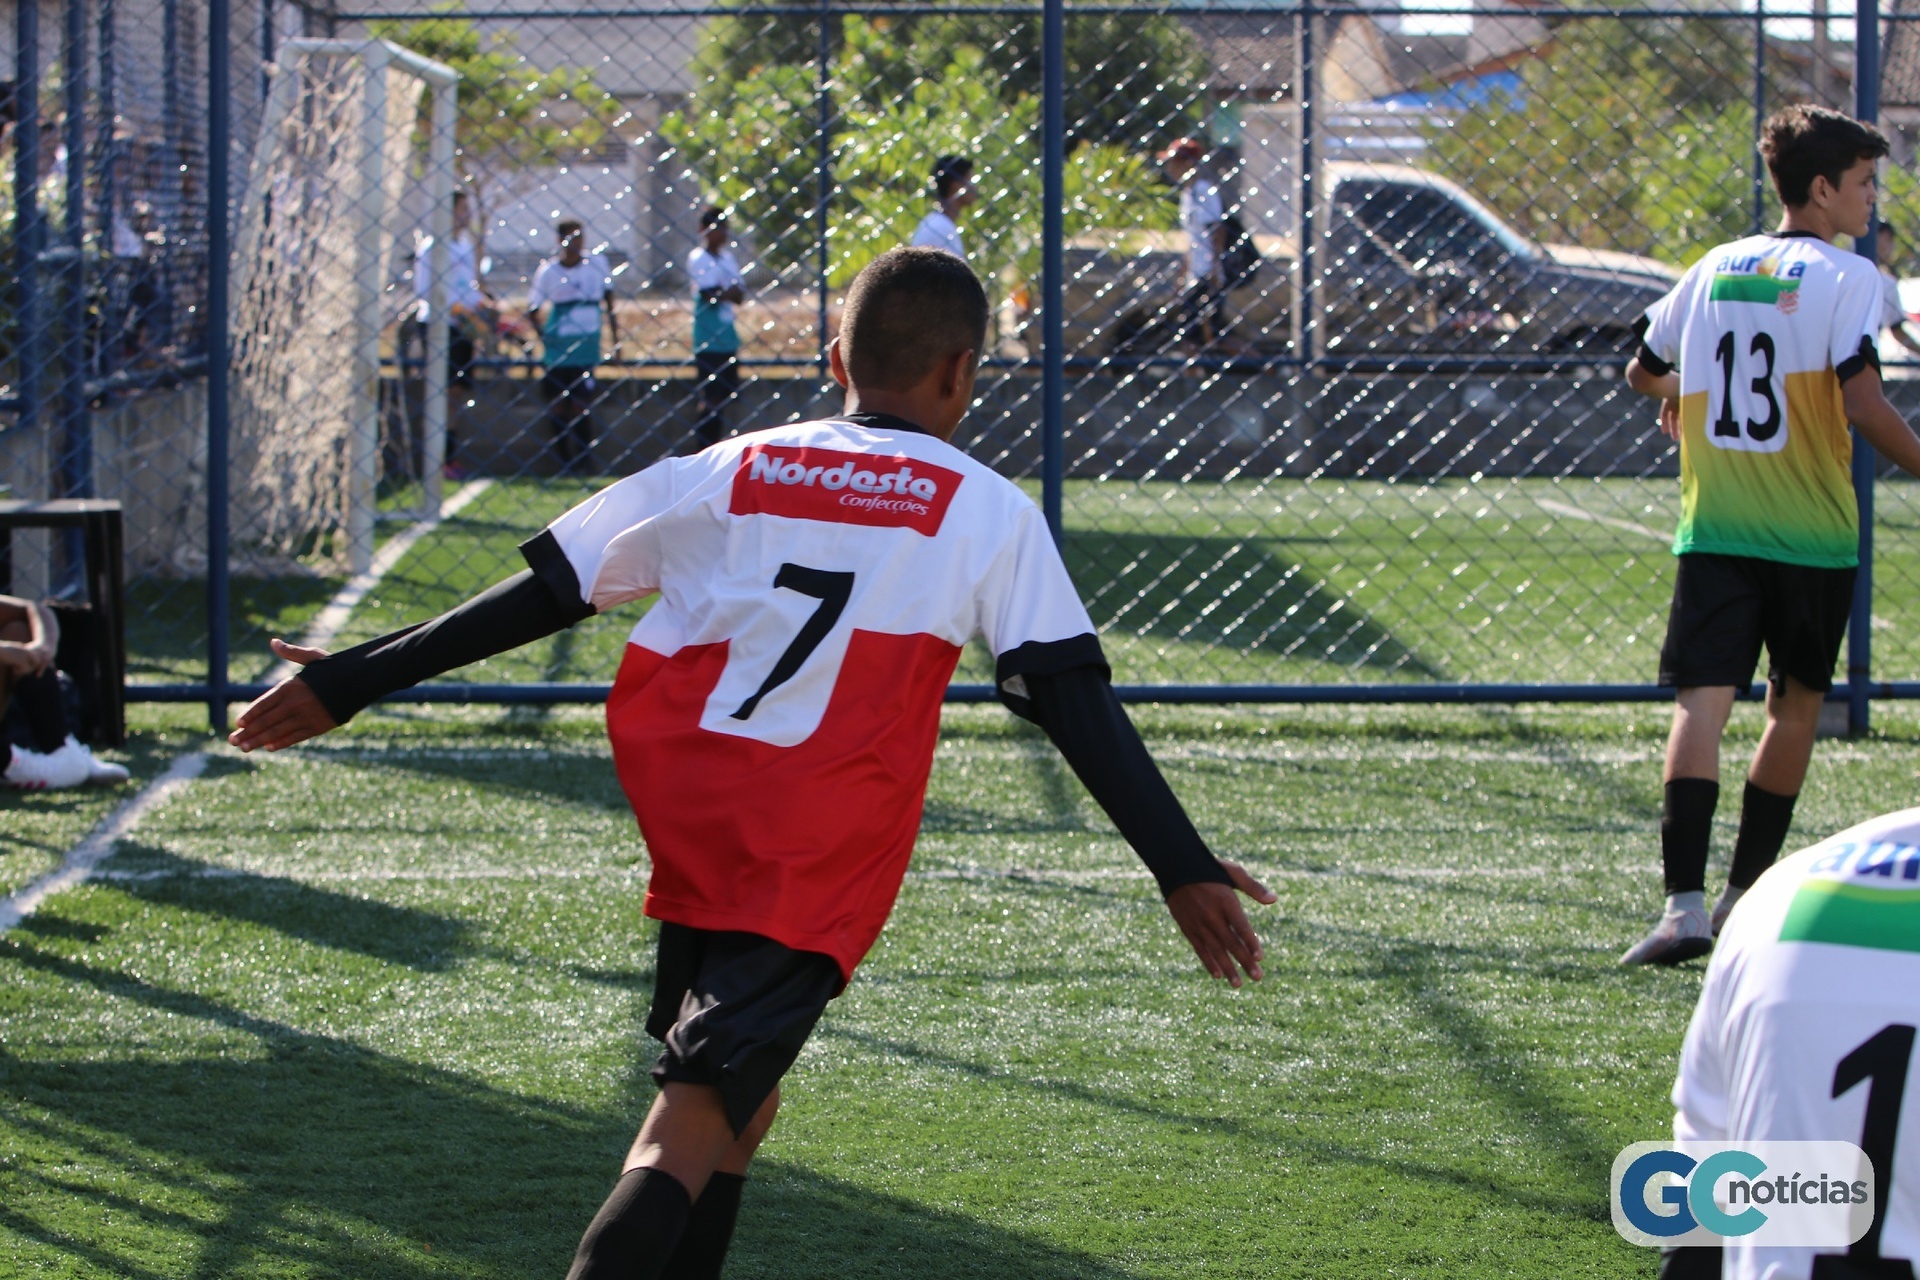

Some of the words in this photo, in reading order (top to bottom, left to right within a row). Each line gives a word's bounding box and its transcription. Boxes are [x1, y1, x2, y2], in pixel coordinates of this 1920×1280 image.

[1715, 331, 1781, 441] 13
[749, 452, 937, 502] Nordeste
[839, 493, 930, 516] Confecções
[729, 562, 855, 720] 7
